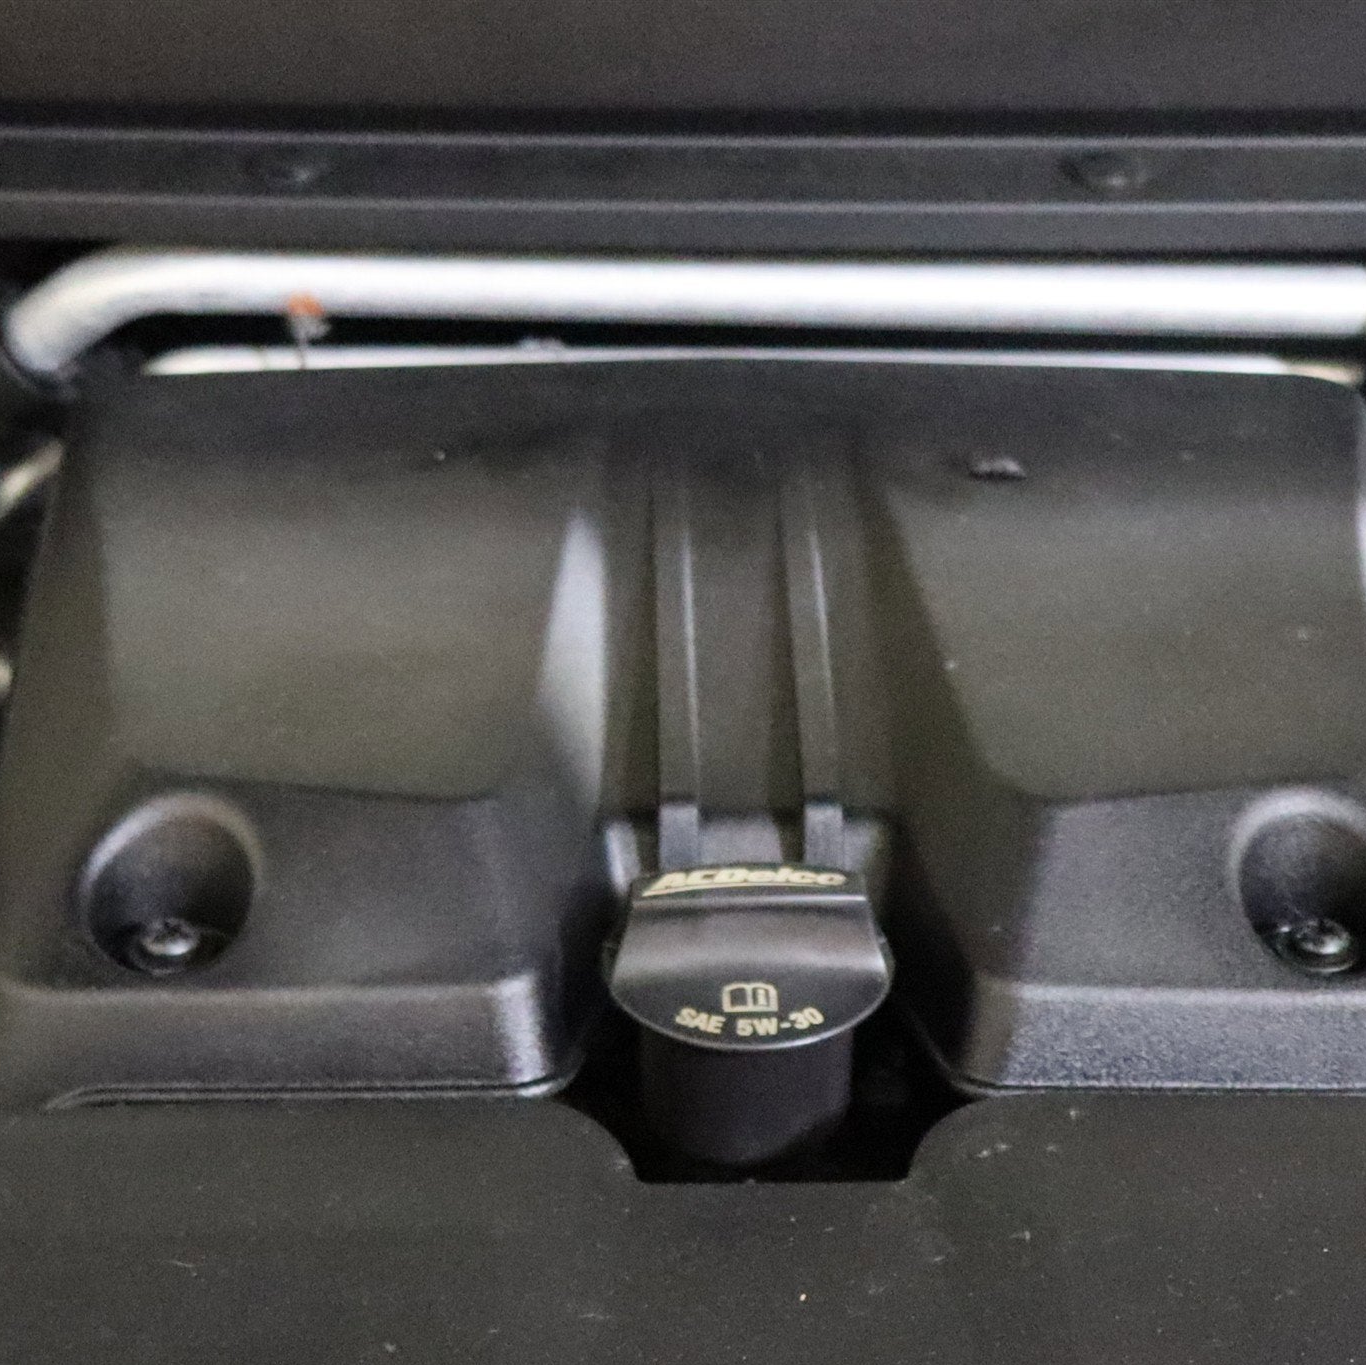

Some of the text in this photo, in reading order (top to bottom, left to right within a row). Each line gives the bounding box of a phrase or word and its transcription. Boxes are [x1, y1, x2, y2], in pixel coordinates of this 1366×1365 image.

[644, 867, 847, 895] ACDelco
[675, 1007, 825, 1036] SAE 5W-30
